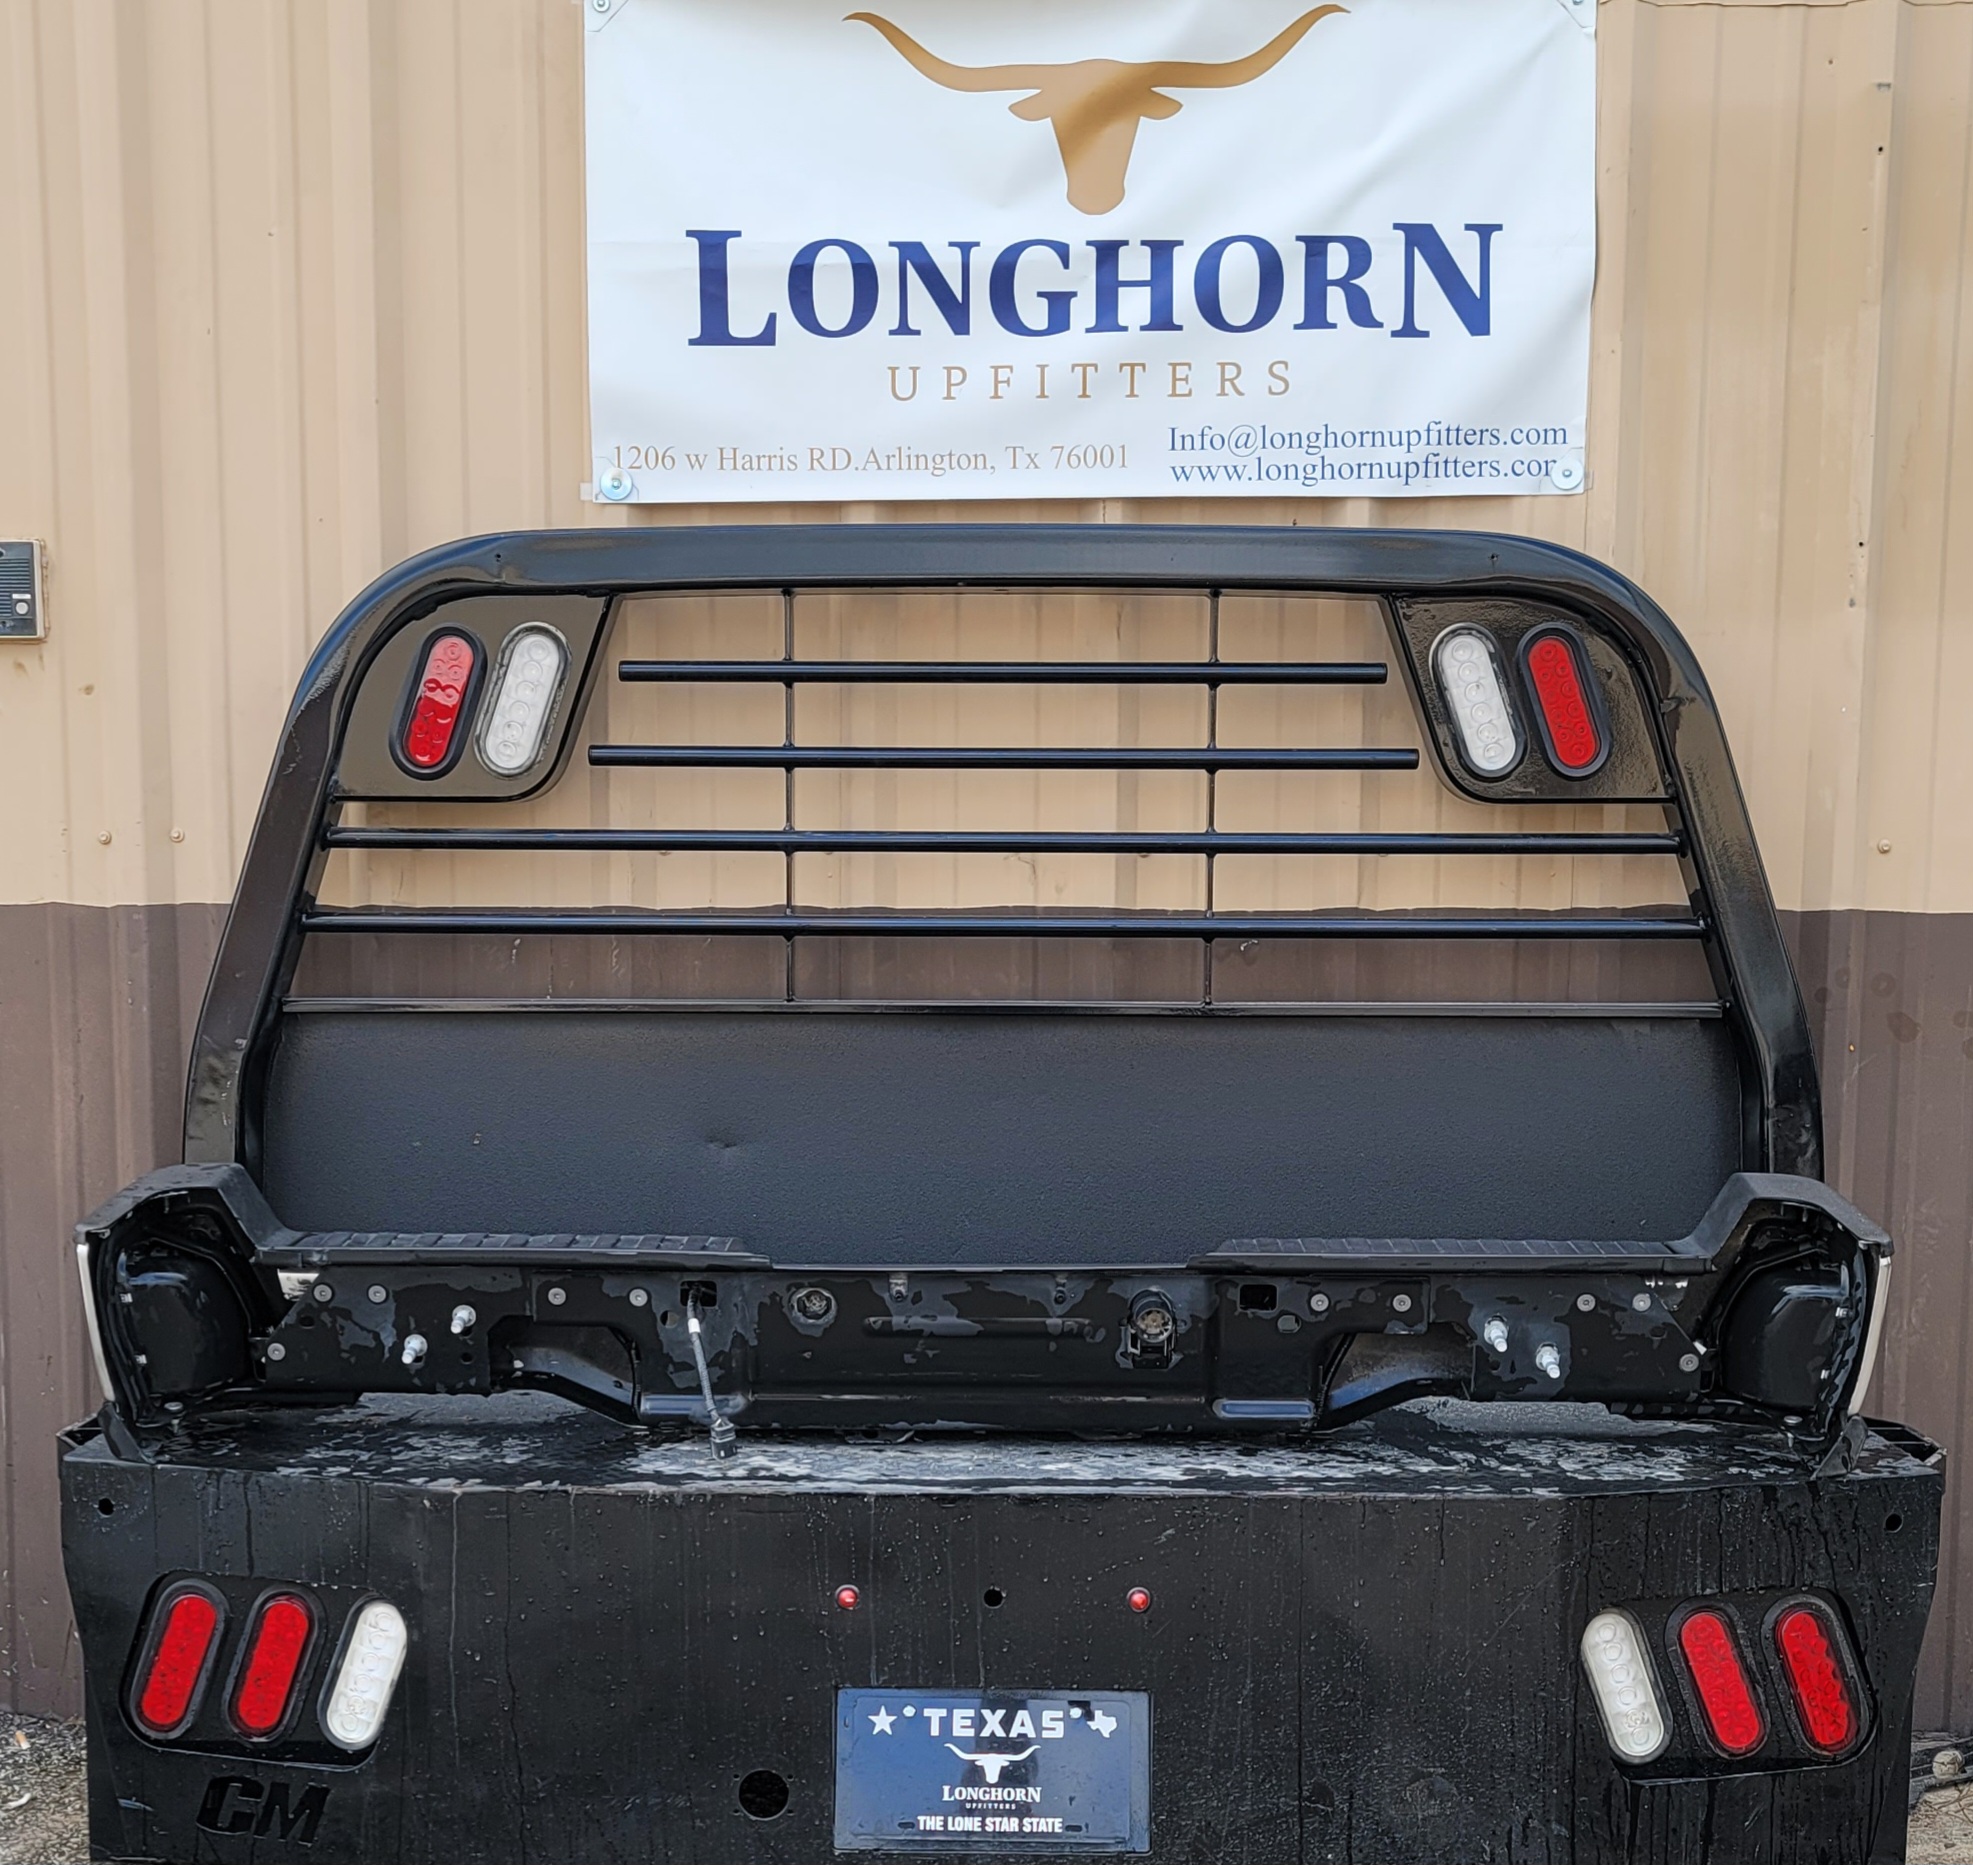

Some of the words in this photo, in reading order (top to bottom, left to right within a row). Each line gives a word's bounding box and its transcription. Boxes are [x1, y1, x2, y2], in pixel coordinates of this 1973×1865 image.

[685, 222, 1504, 347] LONGHORN
[887, 360, 1291, 402] UPFITTERS
[1168, 421, 1569, 458] Info@longhornupfitters.com
[613, 445, 676, 471] 1206
[685, 453, 709, 471] w
[717, 446, 798, 471] Harris
[1005, 445, 1041, 470] Tx
[1050, 444, 1129, 470] 76001
[923, 1708, 1064, 1739] TEXAS
[942, 1785, 1042, 1803] LONGHORN
[965, 1802, 1017, 1810] UPFITTERS
[196, 1775, 331, 1847] CM
[917, 1815, 944, 1831] THE
[947, 1816, 982, 1832] LONE
[985, 1817, 1019, 1832] STAR
[1023, 1817, 1063, 1833] STATE
